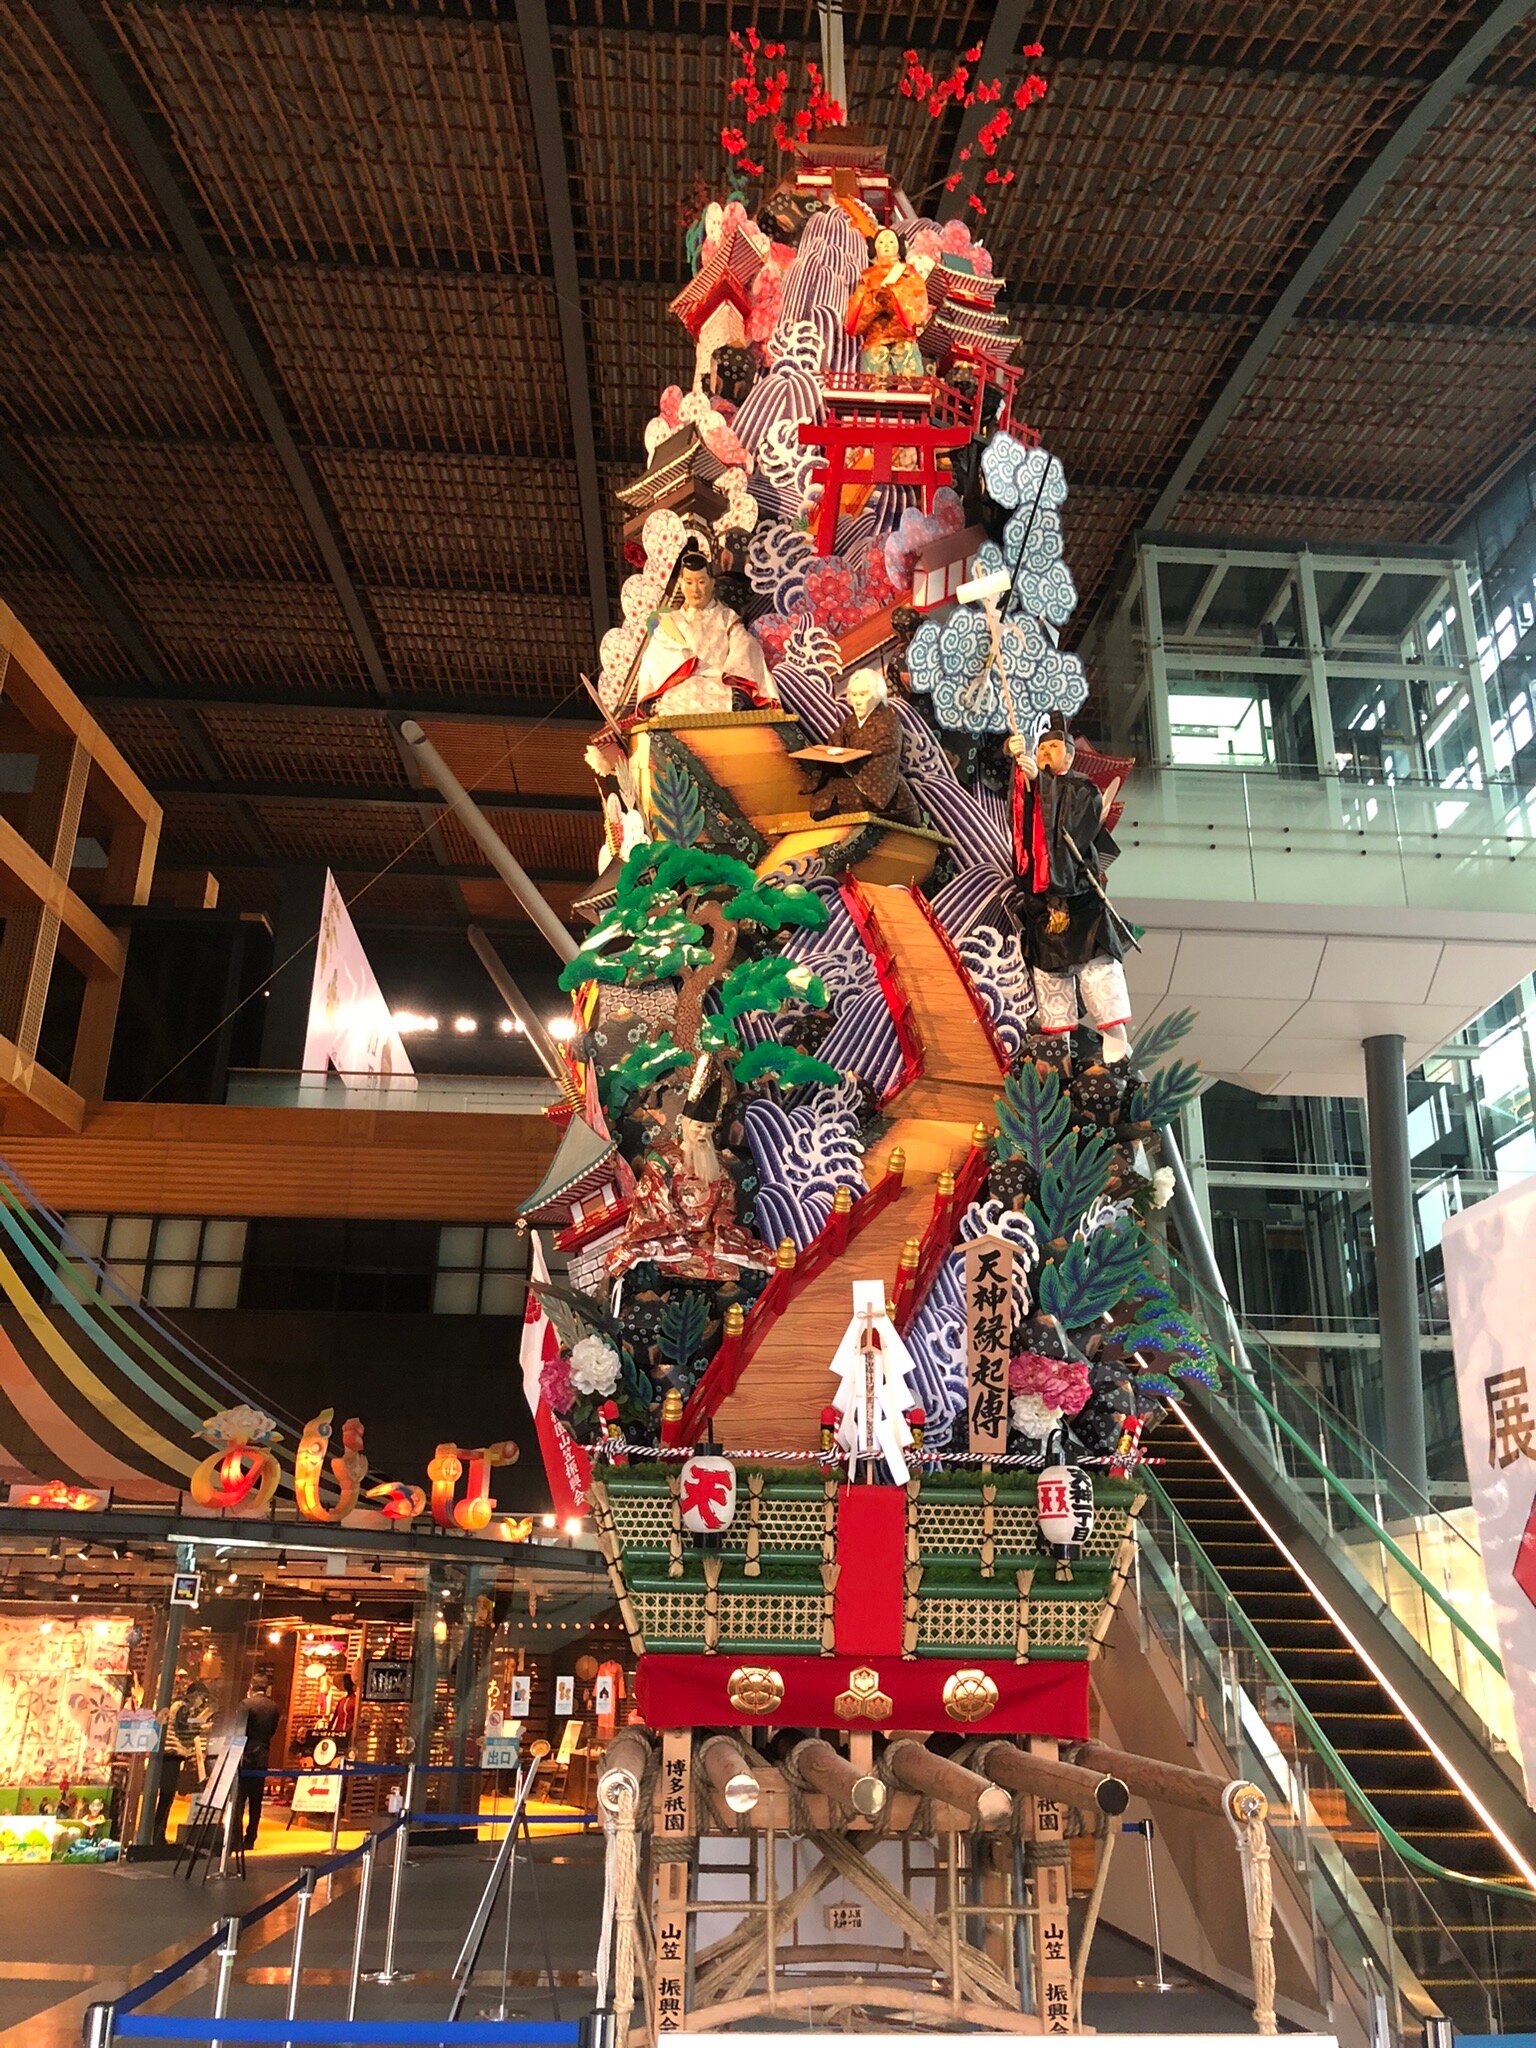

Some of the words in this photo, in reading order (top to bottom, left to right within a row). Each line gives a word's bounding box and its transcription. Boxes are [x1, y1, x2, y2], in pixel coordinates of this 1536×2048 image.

[1485, 1366, 1536, 1470] 展
[681, 1466, 732, 1529] 天
[1067, 1467, 1093, 1541] 天神一丁目
[121, 1733, 149, 1749] 入口
[487, 1750, 511, 1765] 出口
[660, 1923, 681, 1960] 山笠
[1044, 1923, 1064, 1960] 山笠
